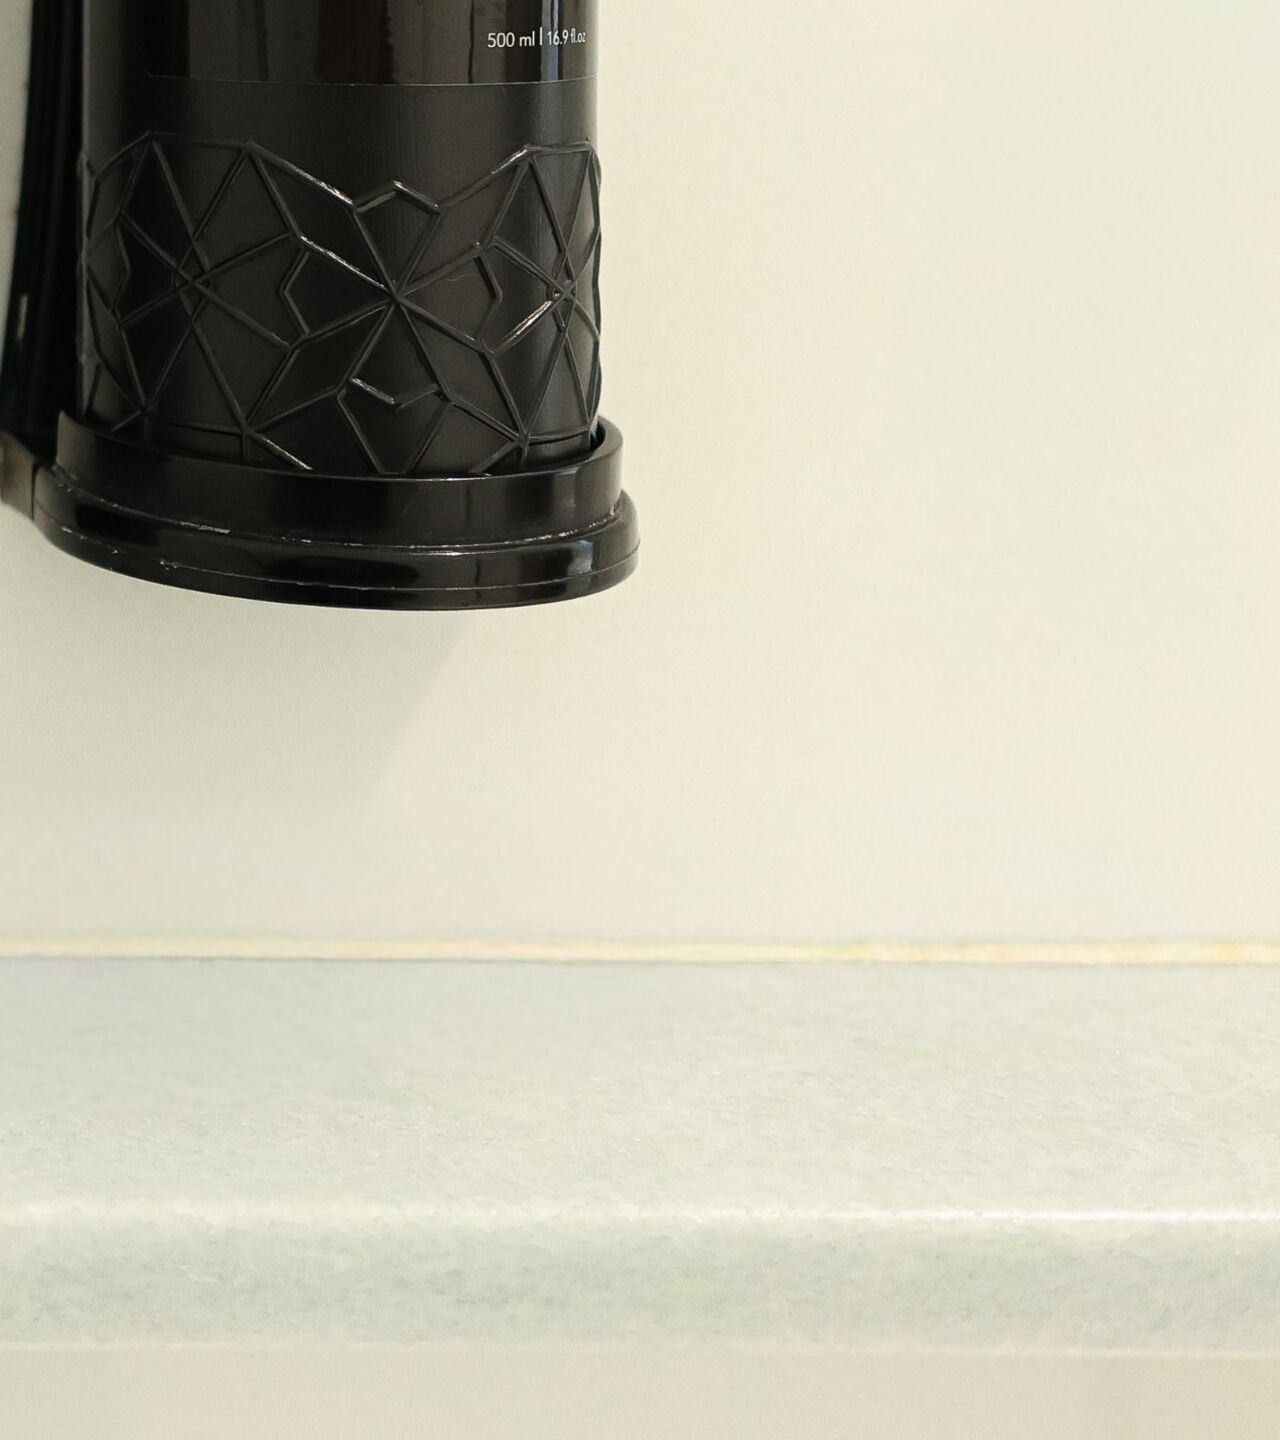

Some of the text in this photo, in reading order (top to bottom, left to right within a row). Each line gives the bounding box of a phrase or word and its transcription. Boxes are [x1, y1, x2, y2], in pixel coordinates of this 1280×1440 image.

[487, 32, 516, 48] 500
[519, 30, 535, 47] ml
[547, 29, 569, 46] 16.9
